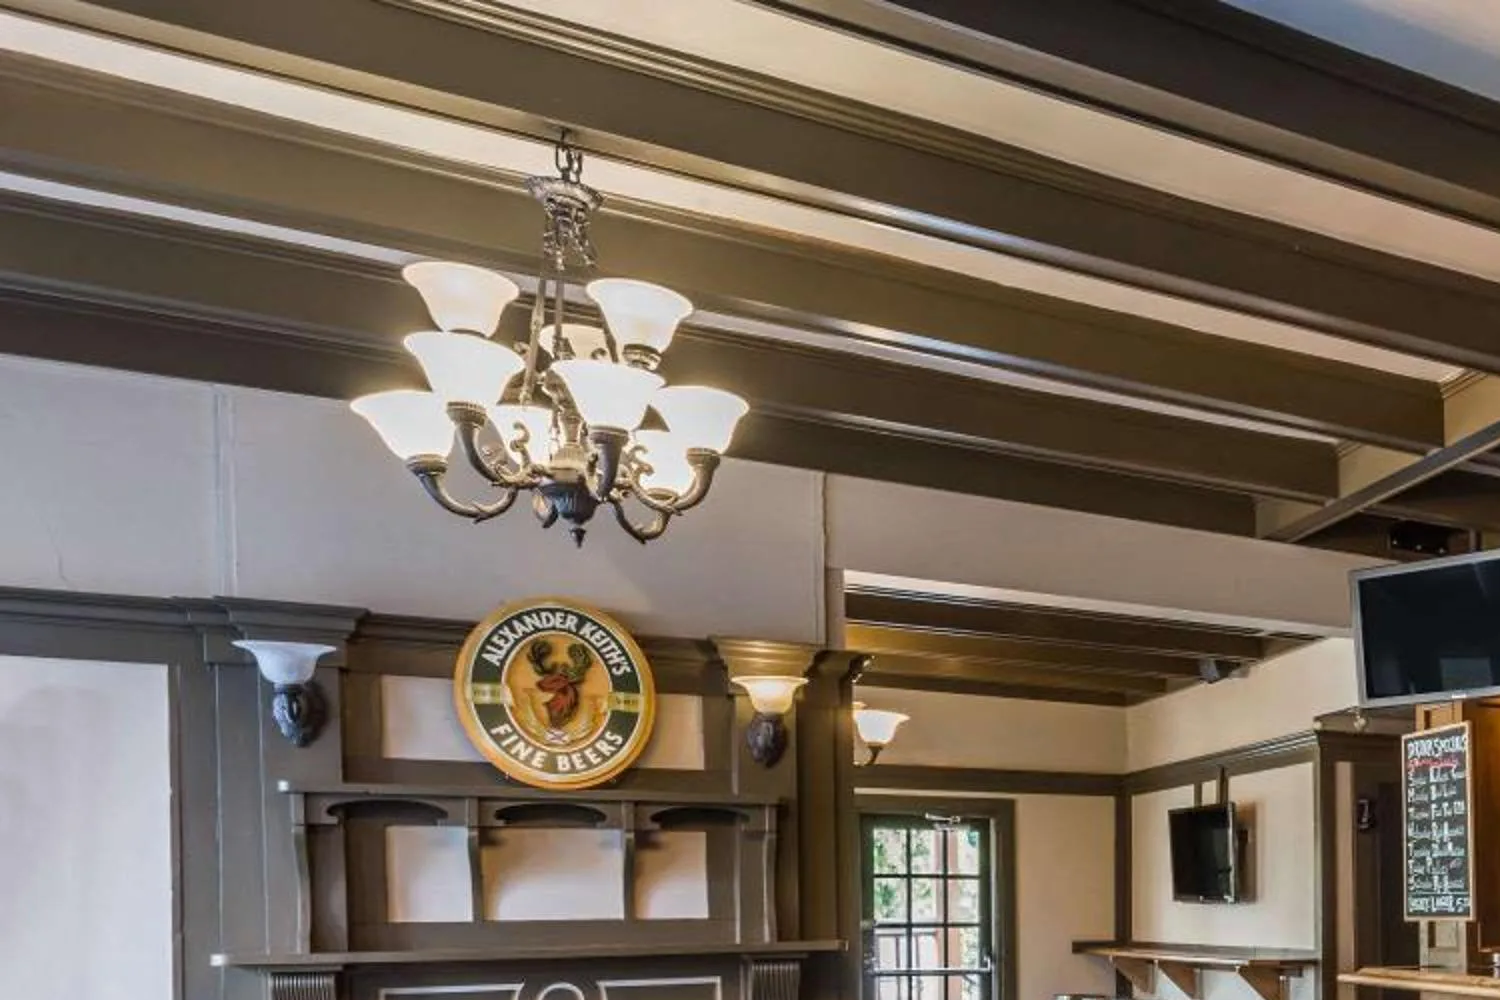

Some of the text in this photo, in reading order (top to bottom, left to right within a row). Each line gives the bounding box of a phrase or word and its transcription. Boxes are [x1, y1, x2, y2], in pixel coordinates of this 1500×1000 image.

[481, 611, 578, 667] ALEXANDER
[490, 723, 623, 772] FINE BEERS
